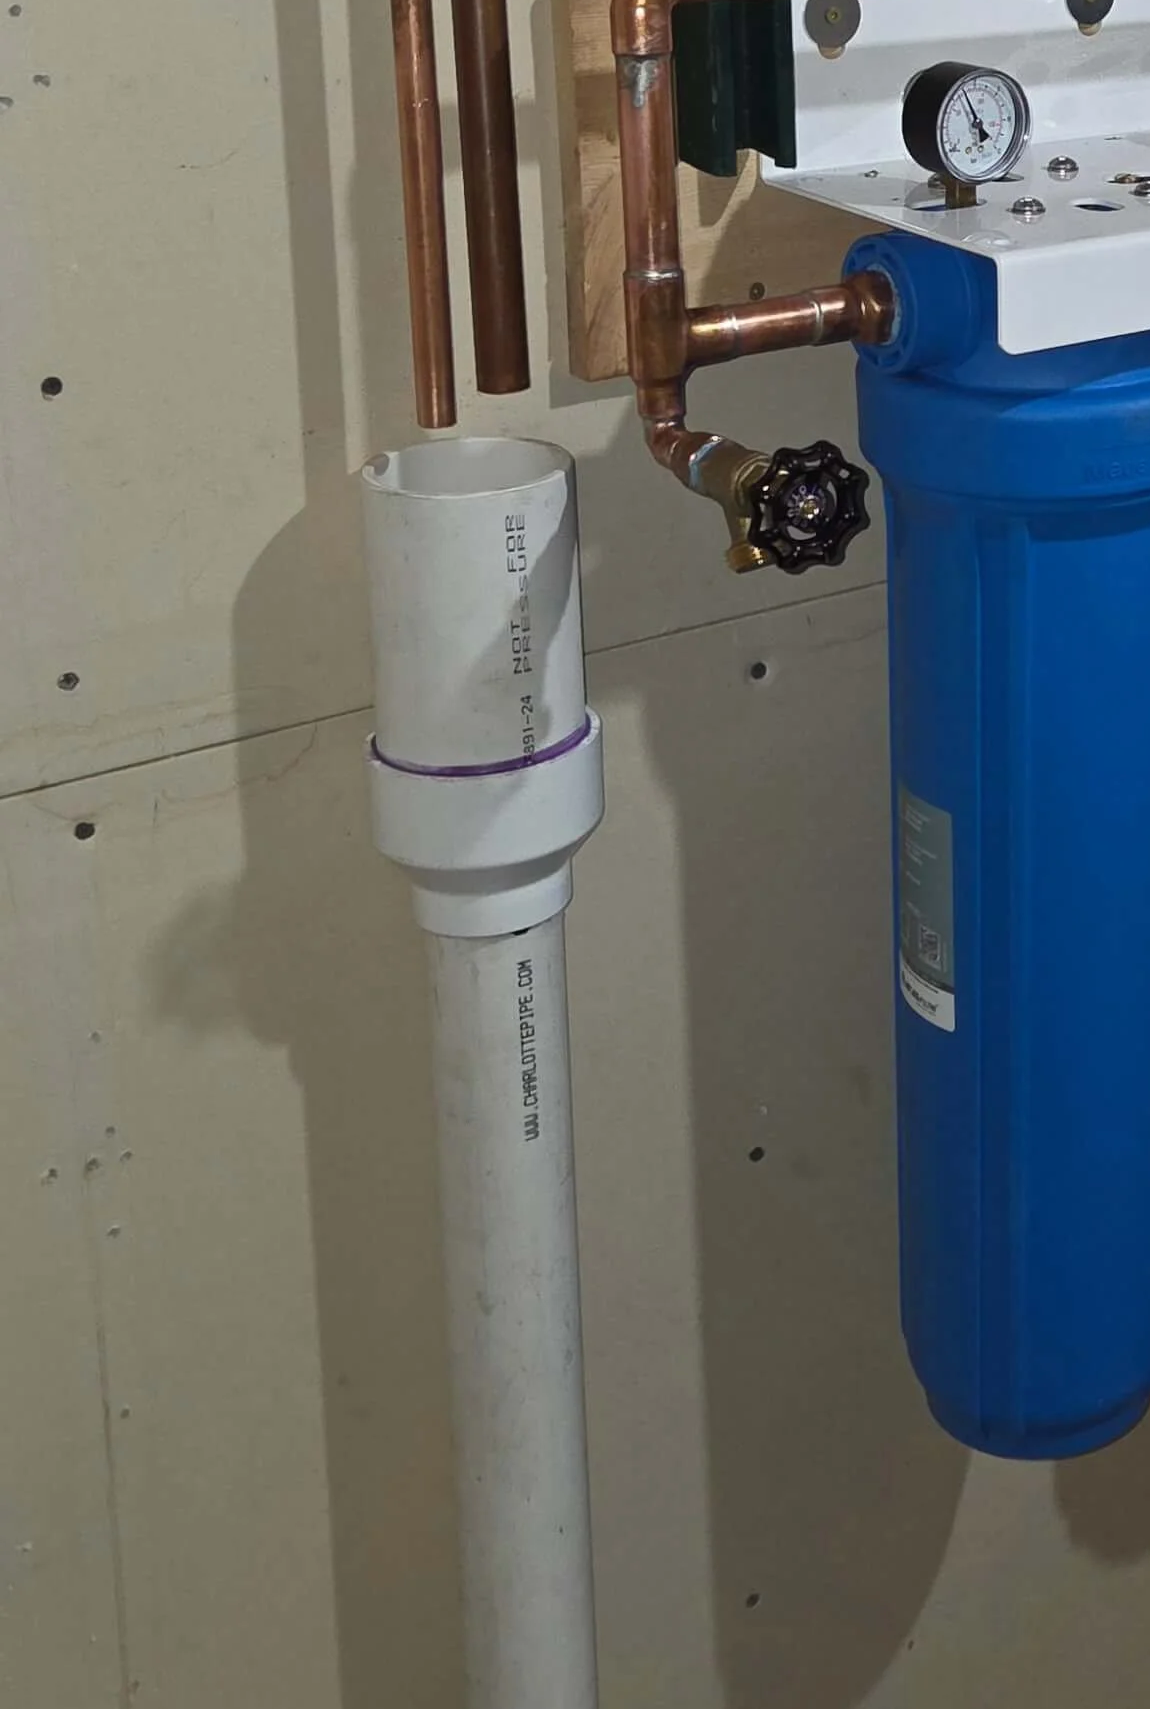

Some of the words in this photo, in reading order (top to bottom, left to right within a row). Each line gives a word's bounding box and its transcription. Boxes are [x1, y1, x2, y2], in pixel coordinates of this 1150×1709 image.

[505, 515, 518, 573] FOR
[515, 514, 533, 673] PRESSURE
[512, 620, 523, 674] NOT
